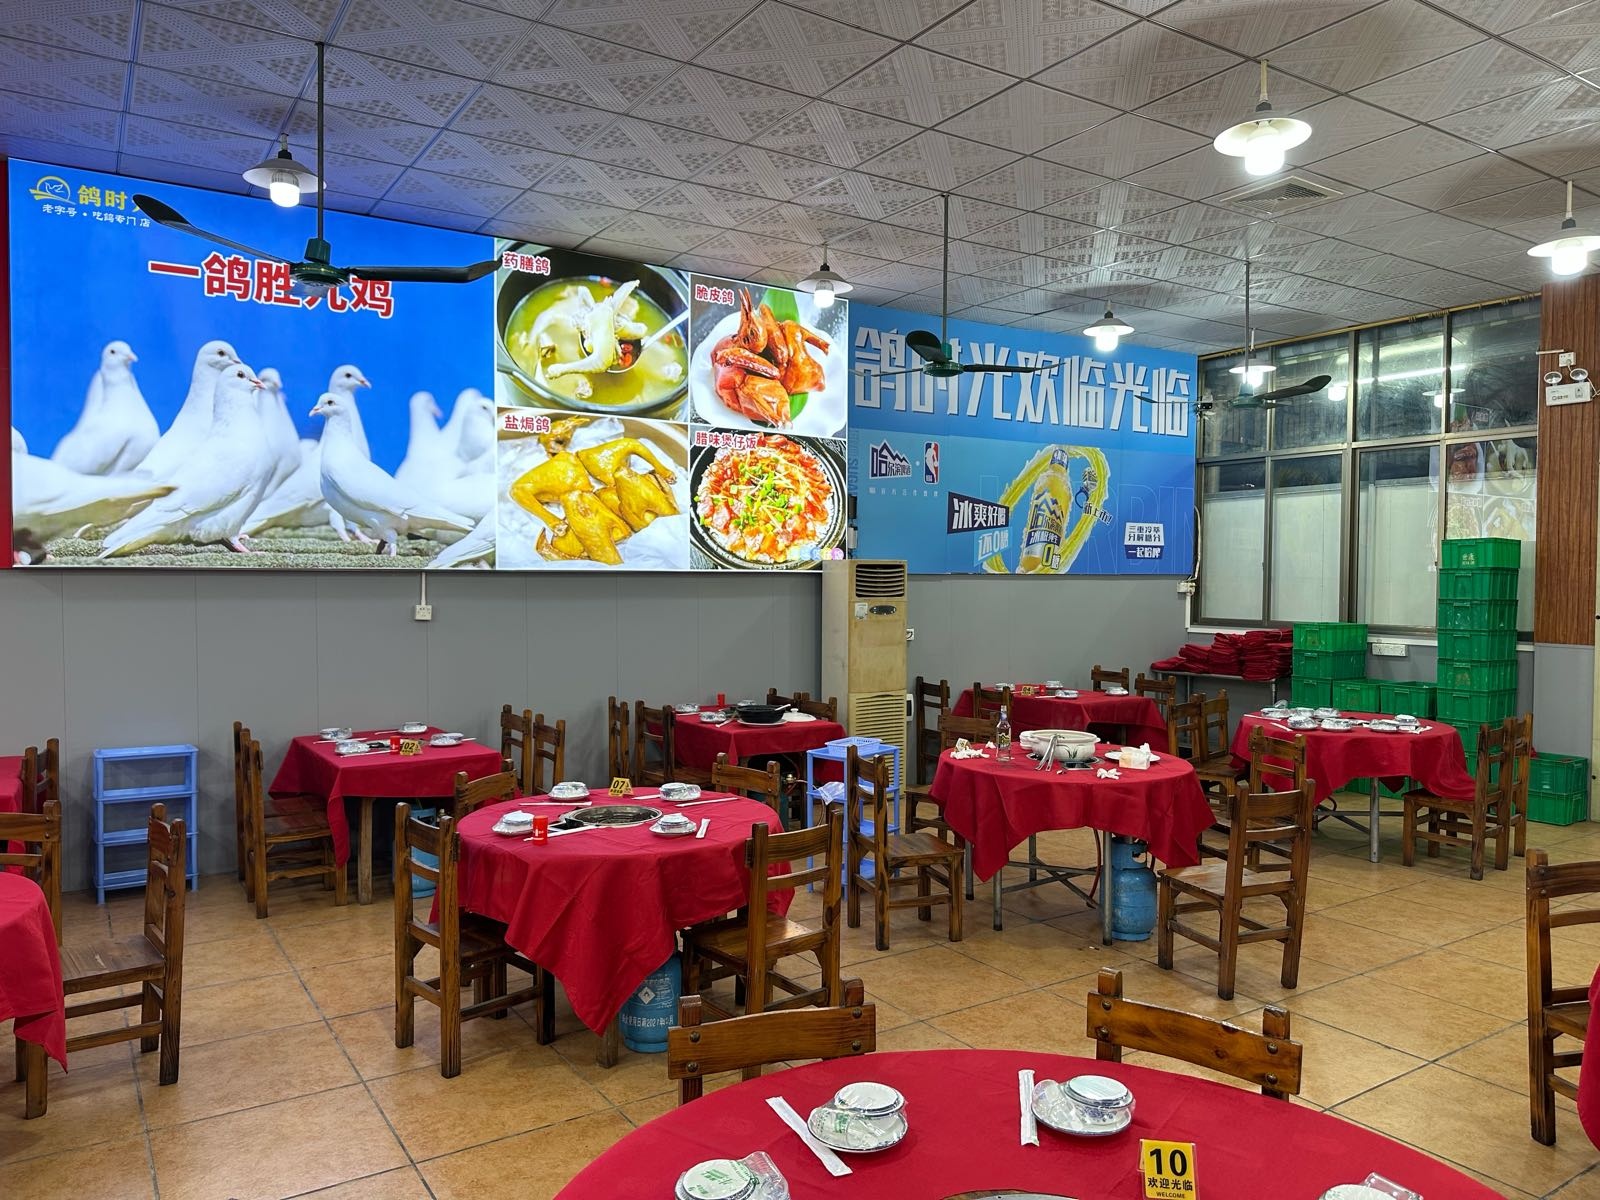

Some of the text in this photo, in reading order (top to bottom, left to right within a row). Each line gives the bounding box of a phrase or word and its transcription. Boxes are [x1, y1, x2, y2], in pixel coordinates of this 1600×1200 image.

[77, 184, 141, 213] 鸽时
[502, 250, 551, 276] 药膳鸽
[695, 283, 735, 307] 脆皮鸽
[503, 413, 552, 434] 盐焗鸽
[695, 430, 758, 450] 腊味煲仔饭
[612, 780, 626, 789] 07
[1149, 1148, 1188, 1177] 10
[1147, 1177, 1194, 1192] 欢迎光临
[1156, 1191, 1186, 1199] WELCOME
